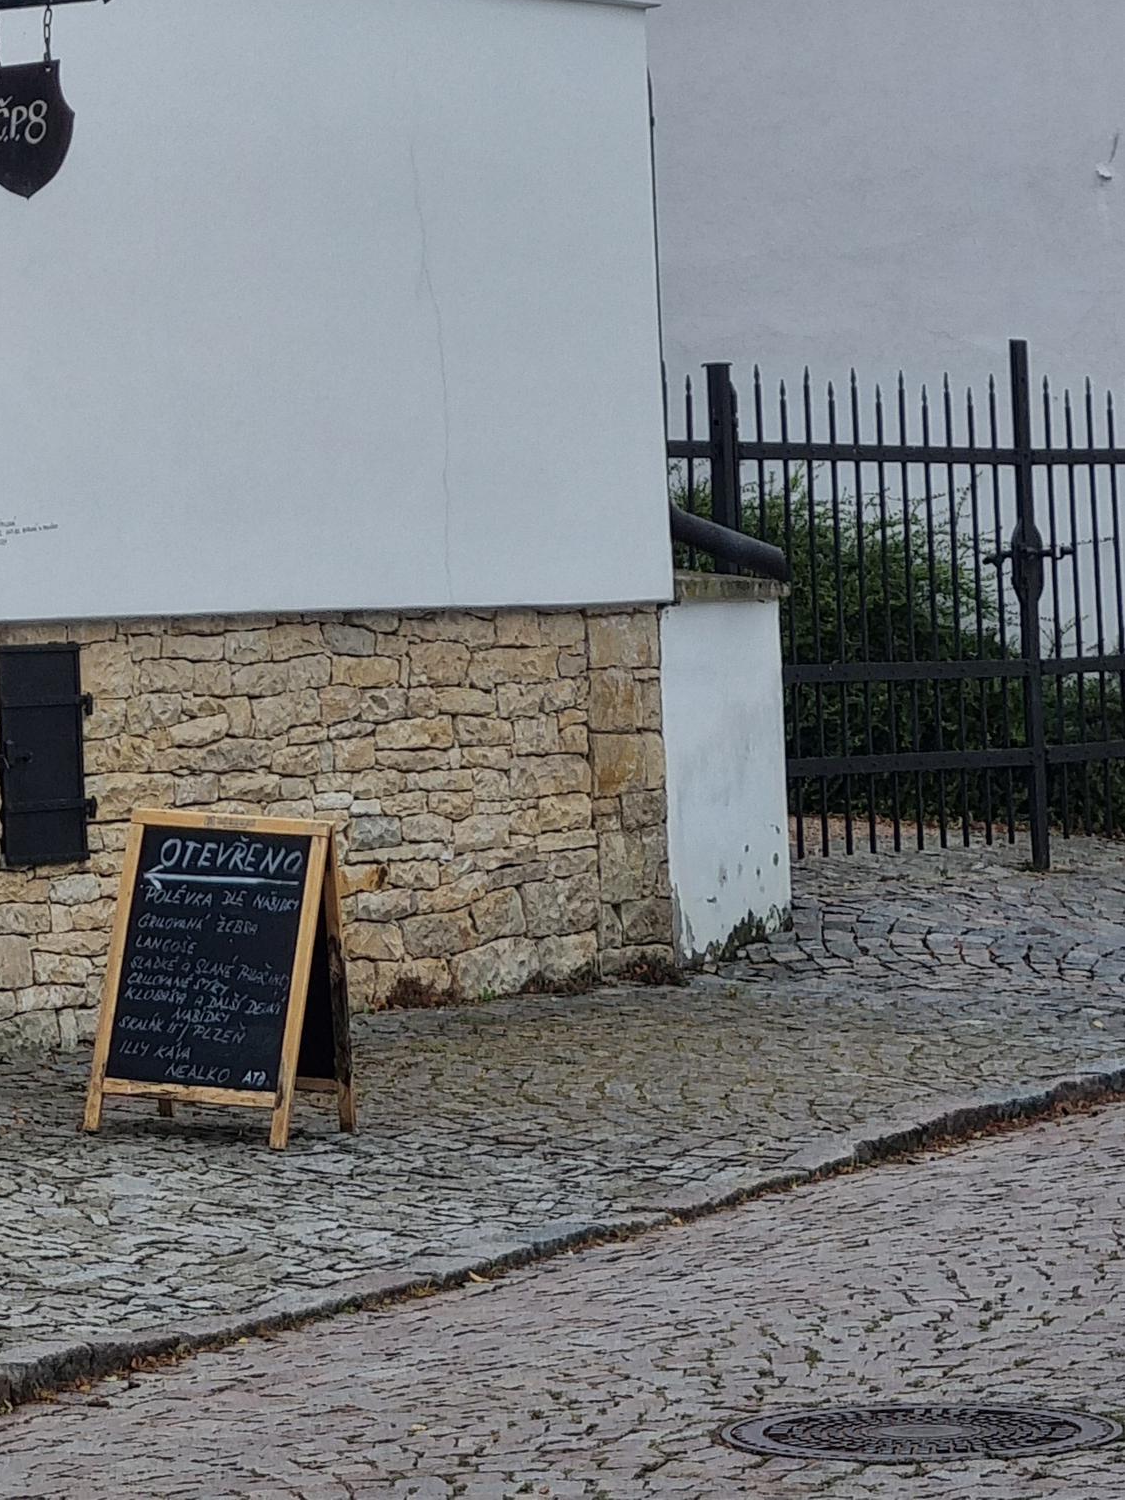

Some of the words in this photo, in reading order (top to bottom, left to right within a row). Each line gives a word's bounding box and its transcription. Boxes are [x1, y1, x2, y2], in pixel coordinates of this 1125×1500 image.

[161, 836, 303, 875] OTEVŘENO
[145, 884, 213, 908] POLÉVKA
[135, 934, 197, 955] LANGOŠE
[130, 955, 180, 971] SLADKÉ
[195, 955, 239, 979] SLANÉ
[192, 1021, 246, 1044] PLZEŇ
[153, 1041, 192, 1061] KÁVA
[164, 1063, 231, 1083] NEALKO
